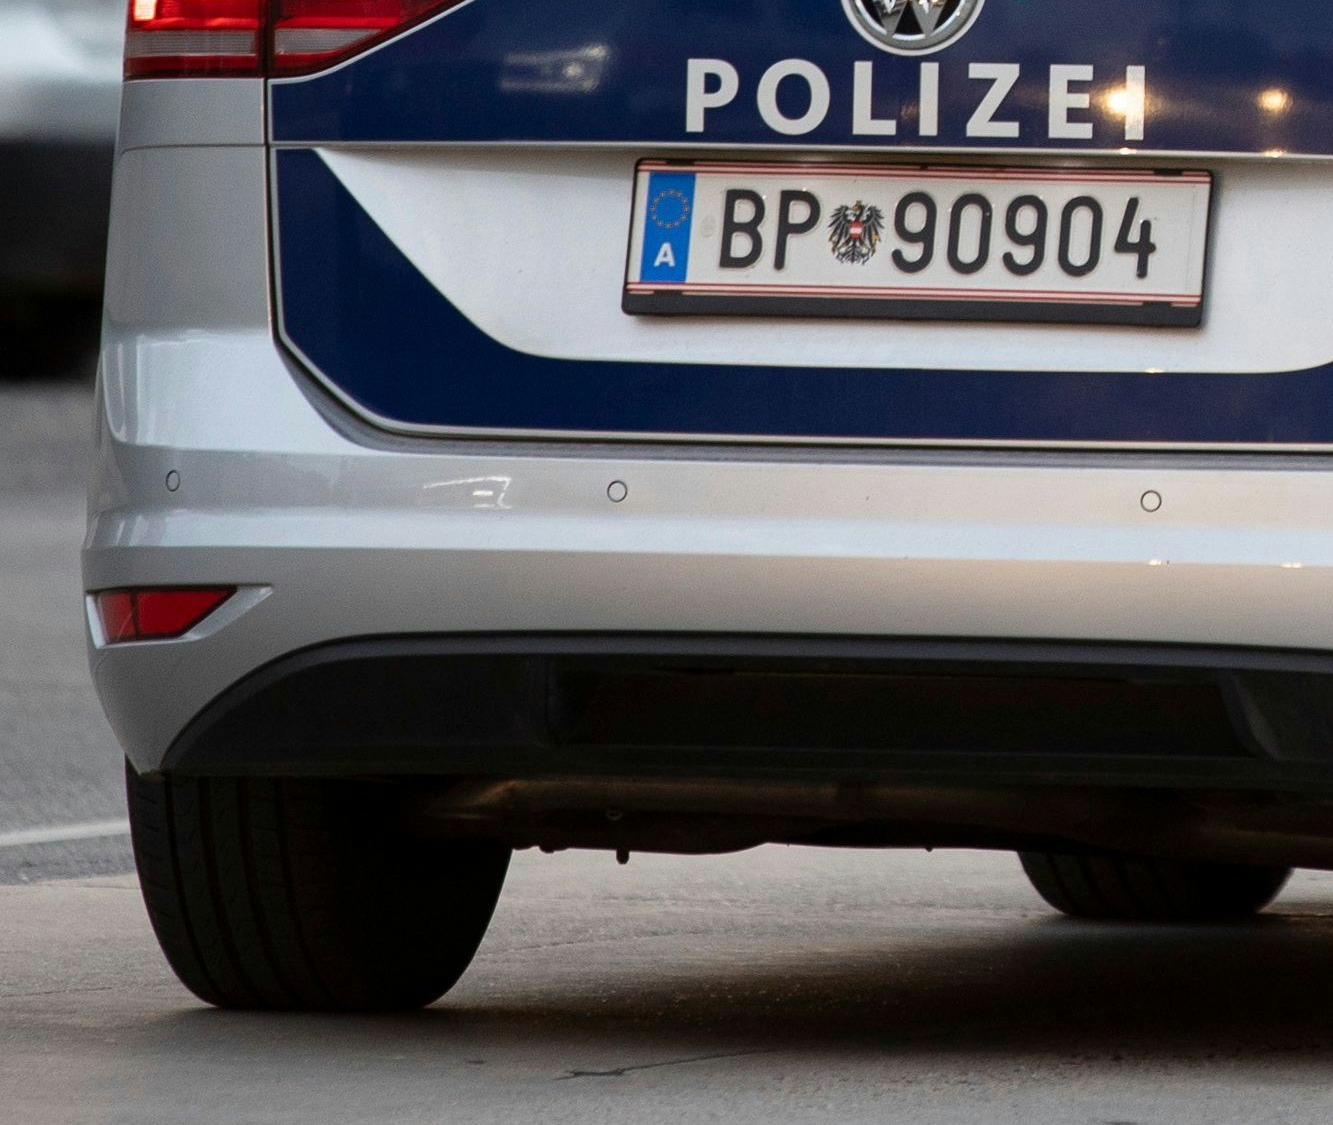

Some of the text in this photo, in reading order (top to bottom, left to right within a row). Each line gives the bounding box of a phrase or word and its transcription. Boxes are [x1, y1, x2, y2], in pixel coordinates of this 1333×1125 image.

[685, 57, 1146, 141] POLIZEI
[653, 241, 676, 268] A
[718, 188, 1157, 279] BP 90904
